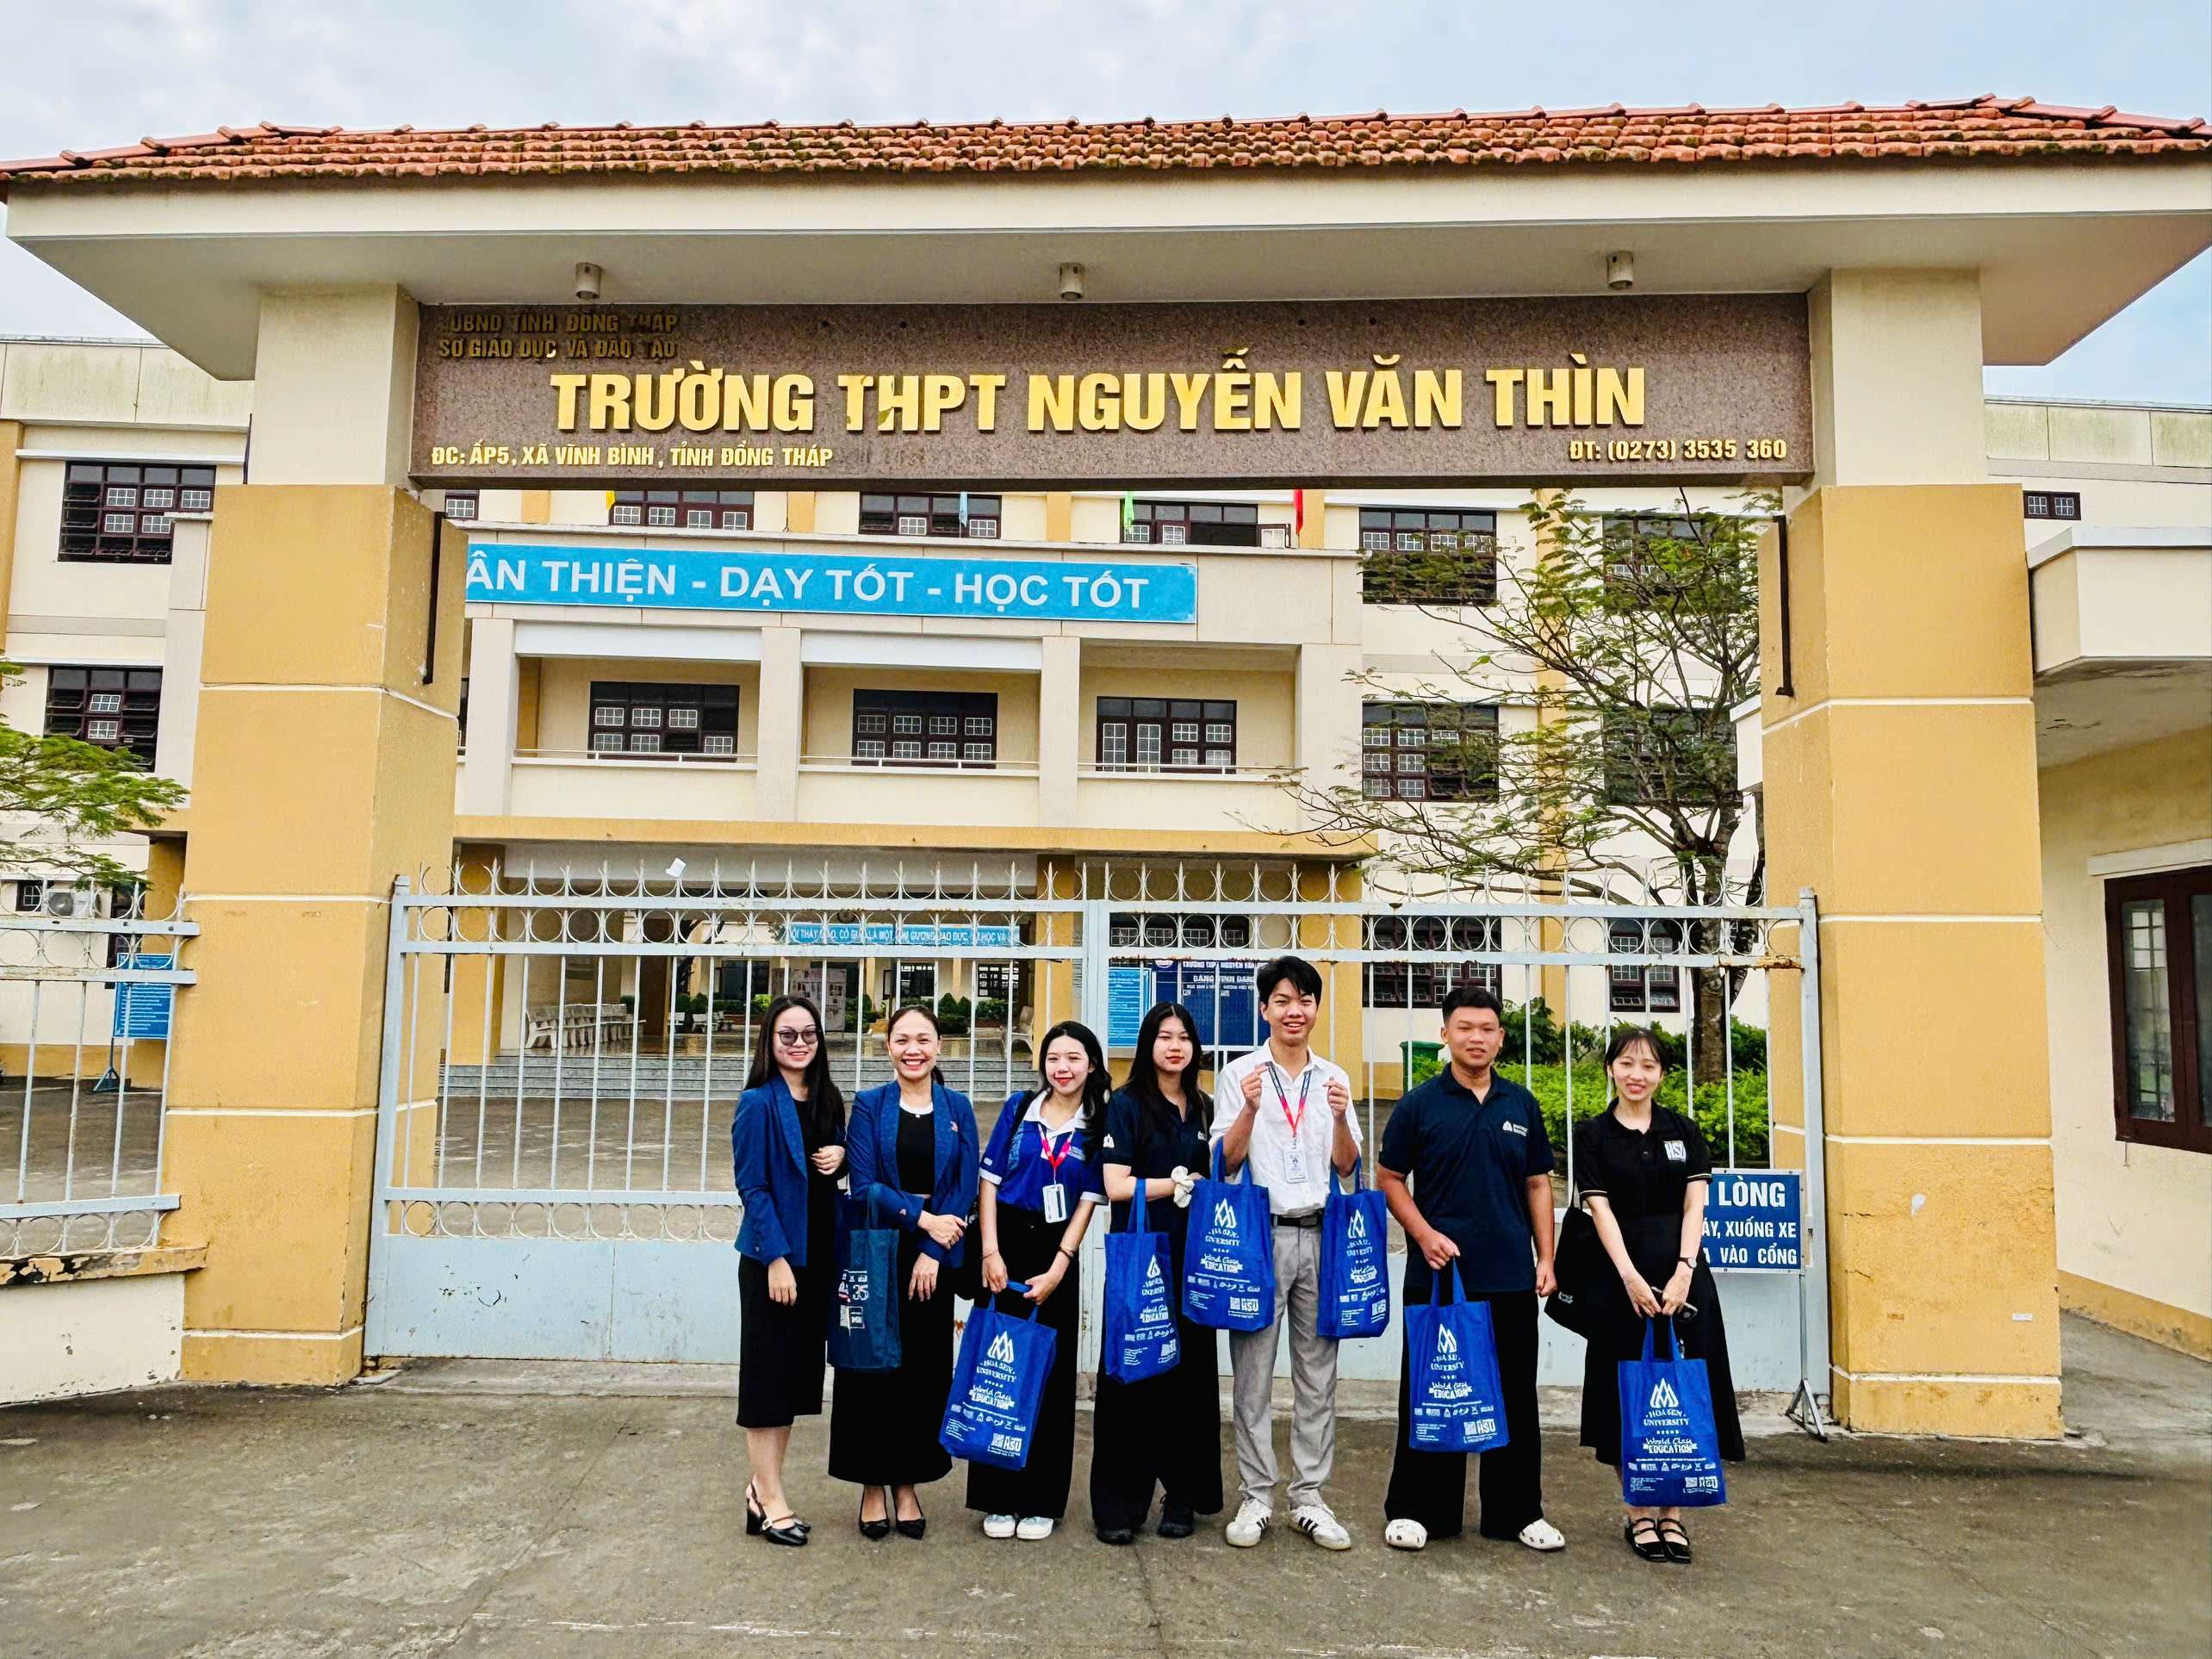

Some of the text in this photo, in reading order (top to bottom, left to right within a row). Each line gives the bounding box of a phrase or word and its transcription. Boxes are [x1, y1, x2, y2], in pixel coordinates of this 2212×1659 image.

[450, 314, 503, 333] UBND
[550, 347, 1645, 432] TRƯỜNG THPT NGUYỄN VĂN THÌN
[431, 444, 466, 465] ĐC:
[469, 439, 518, 467] ẤP5,
[521, 443, 550, 465] XÃ
[556, 443, 601, 466] VĨNH
[670, 440, 714, 467] TỈNH
[720, 439, 774, 467] ĐỒNG
[781, 444, 834, 468] THÁP
[1569, 438, 1787, 462] ĐT: (0273) 3535 360
[541, 558, 676, 602] THIỆN
[720, 565, 814, 606] DẠY
[825, 562, 915, 602] TỐT
[954, 573, 1048, 612] HỌC
[1062, 570, 1150, 608] TỐT
[1718, 1175, 1786, 1208] LÒNG
[1725, 1215, 1774, 1238] XUỐNG
[1778, 1221, 1797, 1238] XE
[1719, 1244, 1749, 1264] VÀO
[1757, 1242, 1798, 1264] CỔNG
[1643, 1418, 1689, 1426] UNIVERSITY
